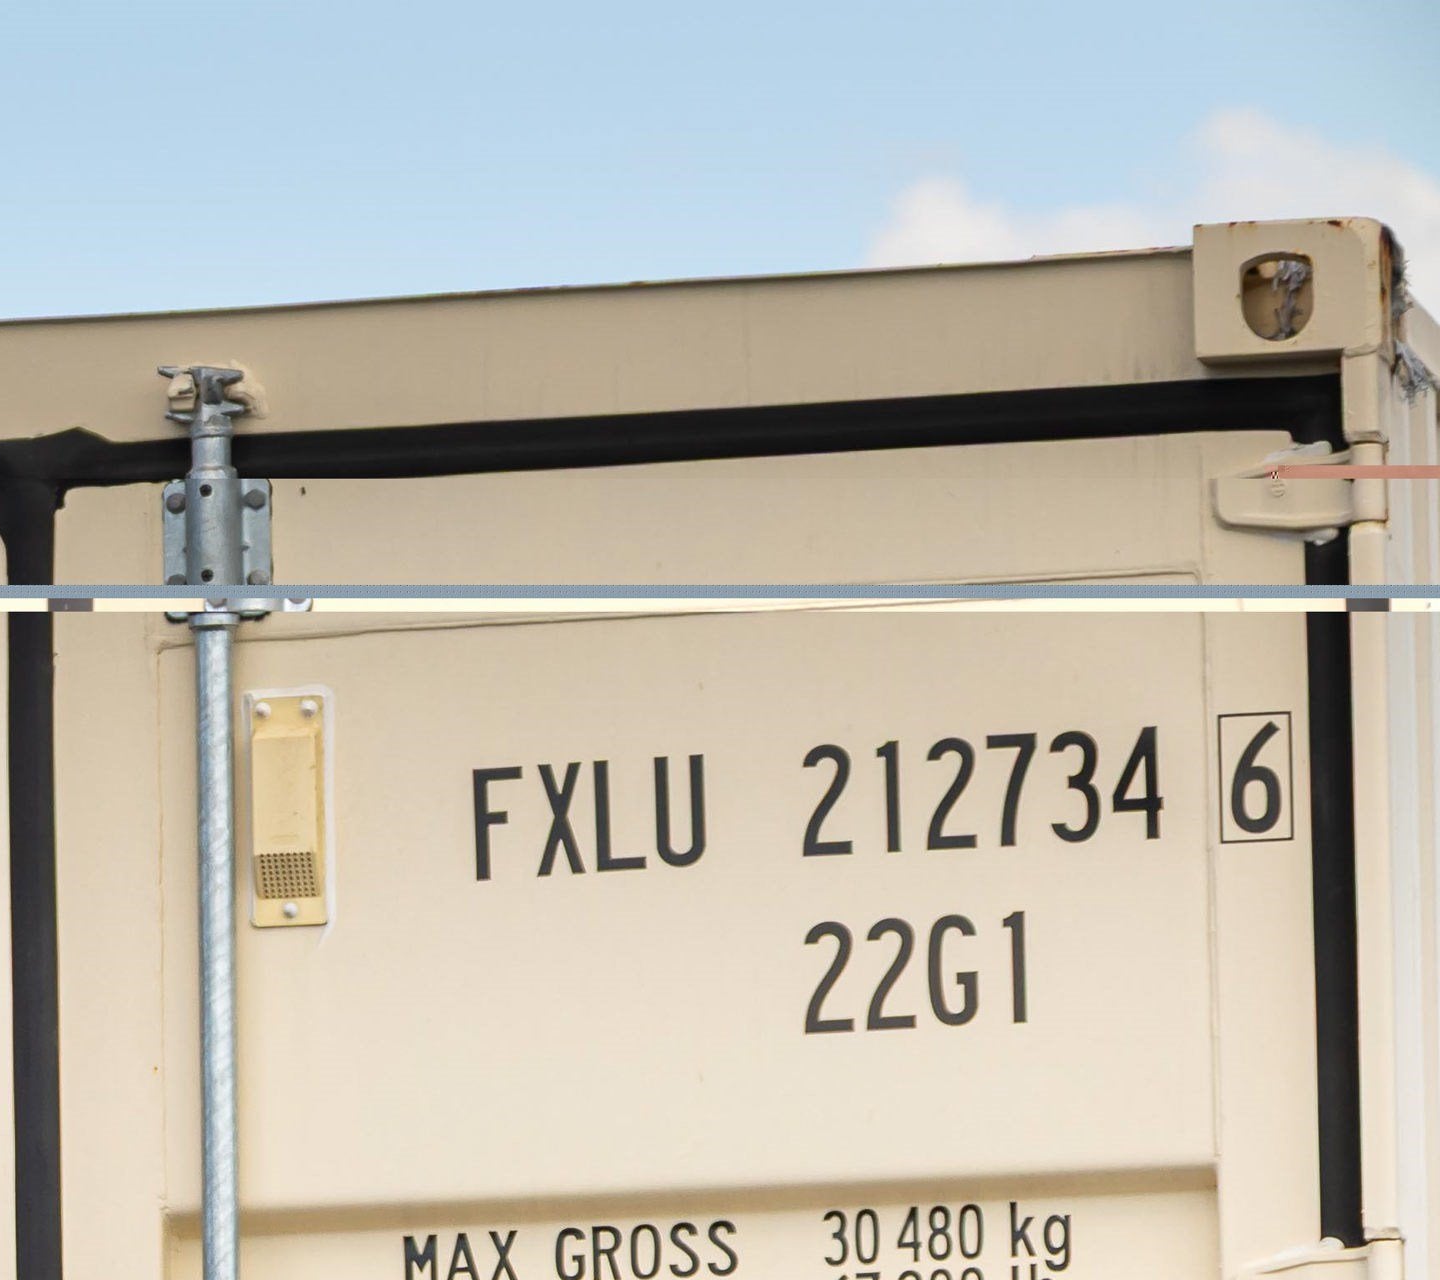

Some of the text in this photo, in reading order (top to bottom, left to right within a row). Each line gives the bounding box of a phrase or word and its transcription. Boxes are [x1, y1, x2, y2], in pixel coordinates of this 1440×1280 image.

[472, 721, 1282, 882] FXLU 212734 6
[804, 910, 1027, 1035] 22G1
[823, 1201, 1071, 1275] 30 480 kg
